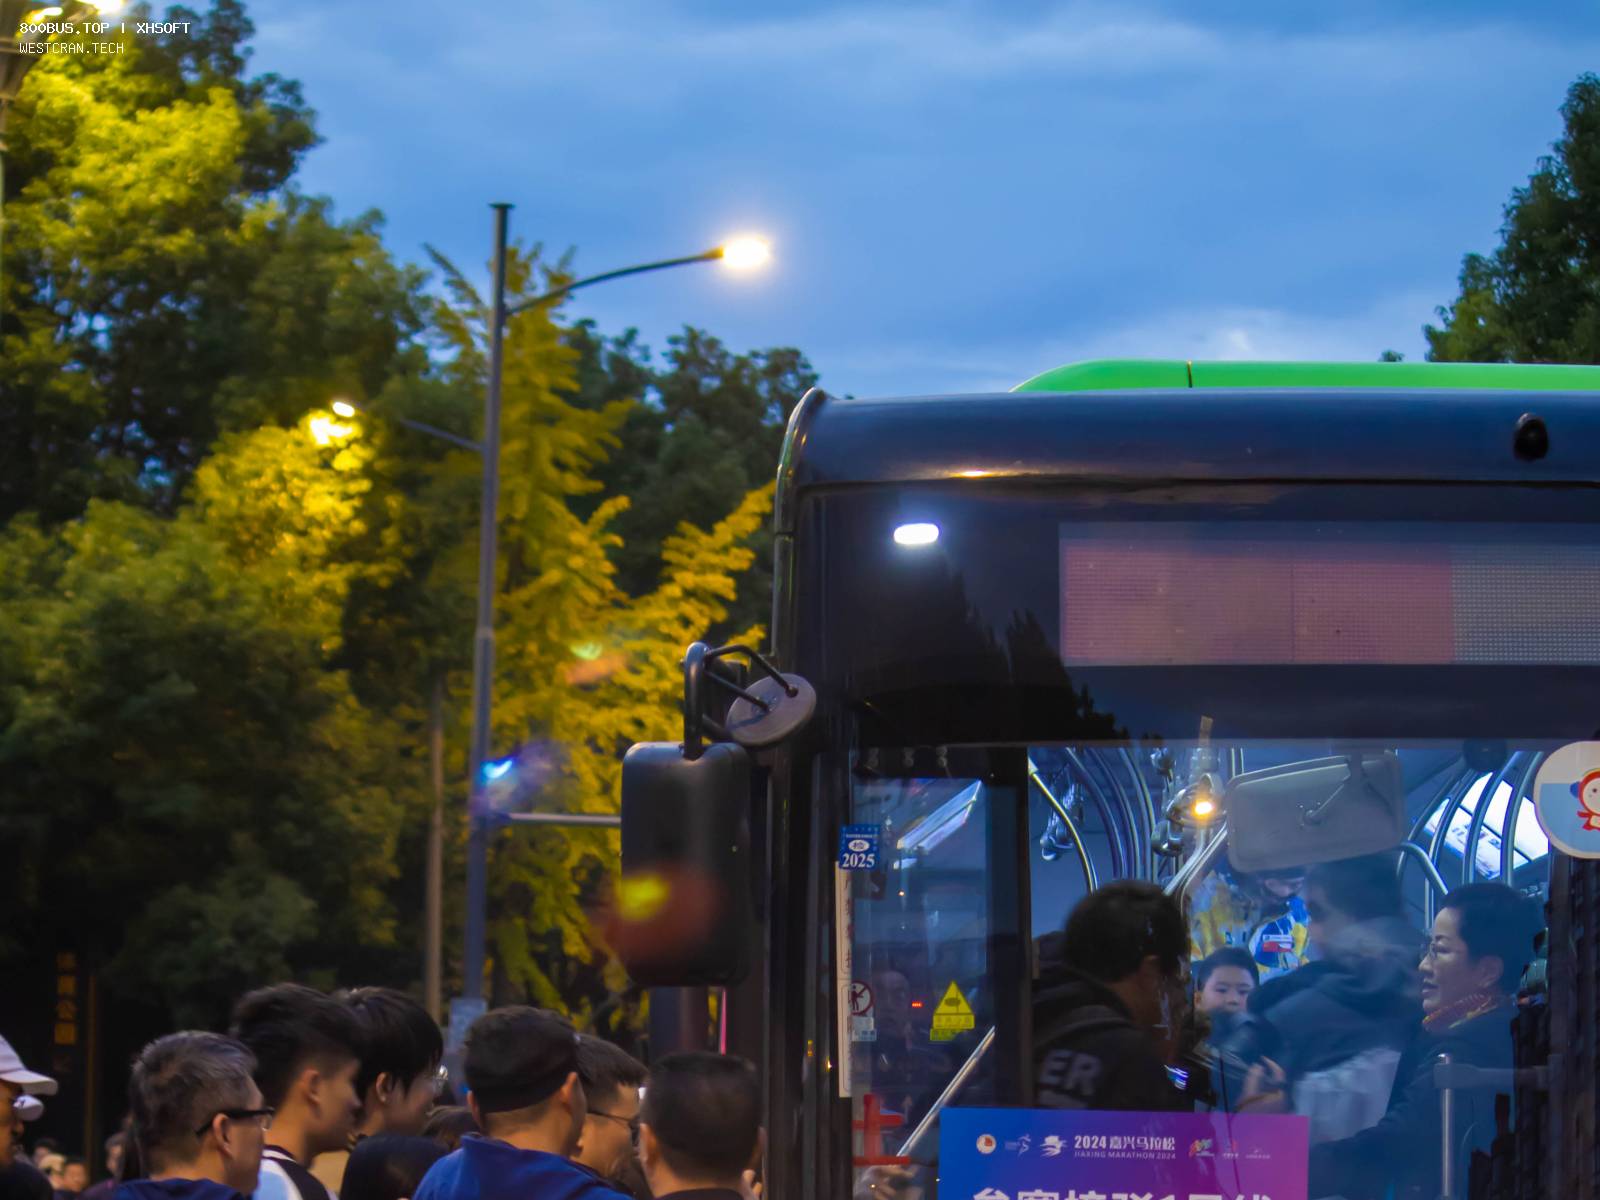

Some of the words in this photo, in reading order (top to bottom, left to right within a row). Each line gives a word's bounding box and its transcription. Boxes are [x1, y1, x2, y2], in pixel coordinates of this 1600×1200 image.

[842, 852, 875, 868] 2025
[1074, 1135, 1107, 1149] 2024
[1109, 1136, 1176, 1151] 嘉兴马拉松
